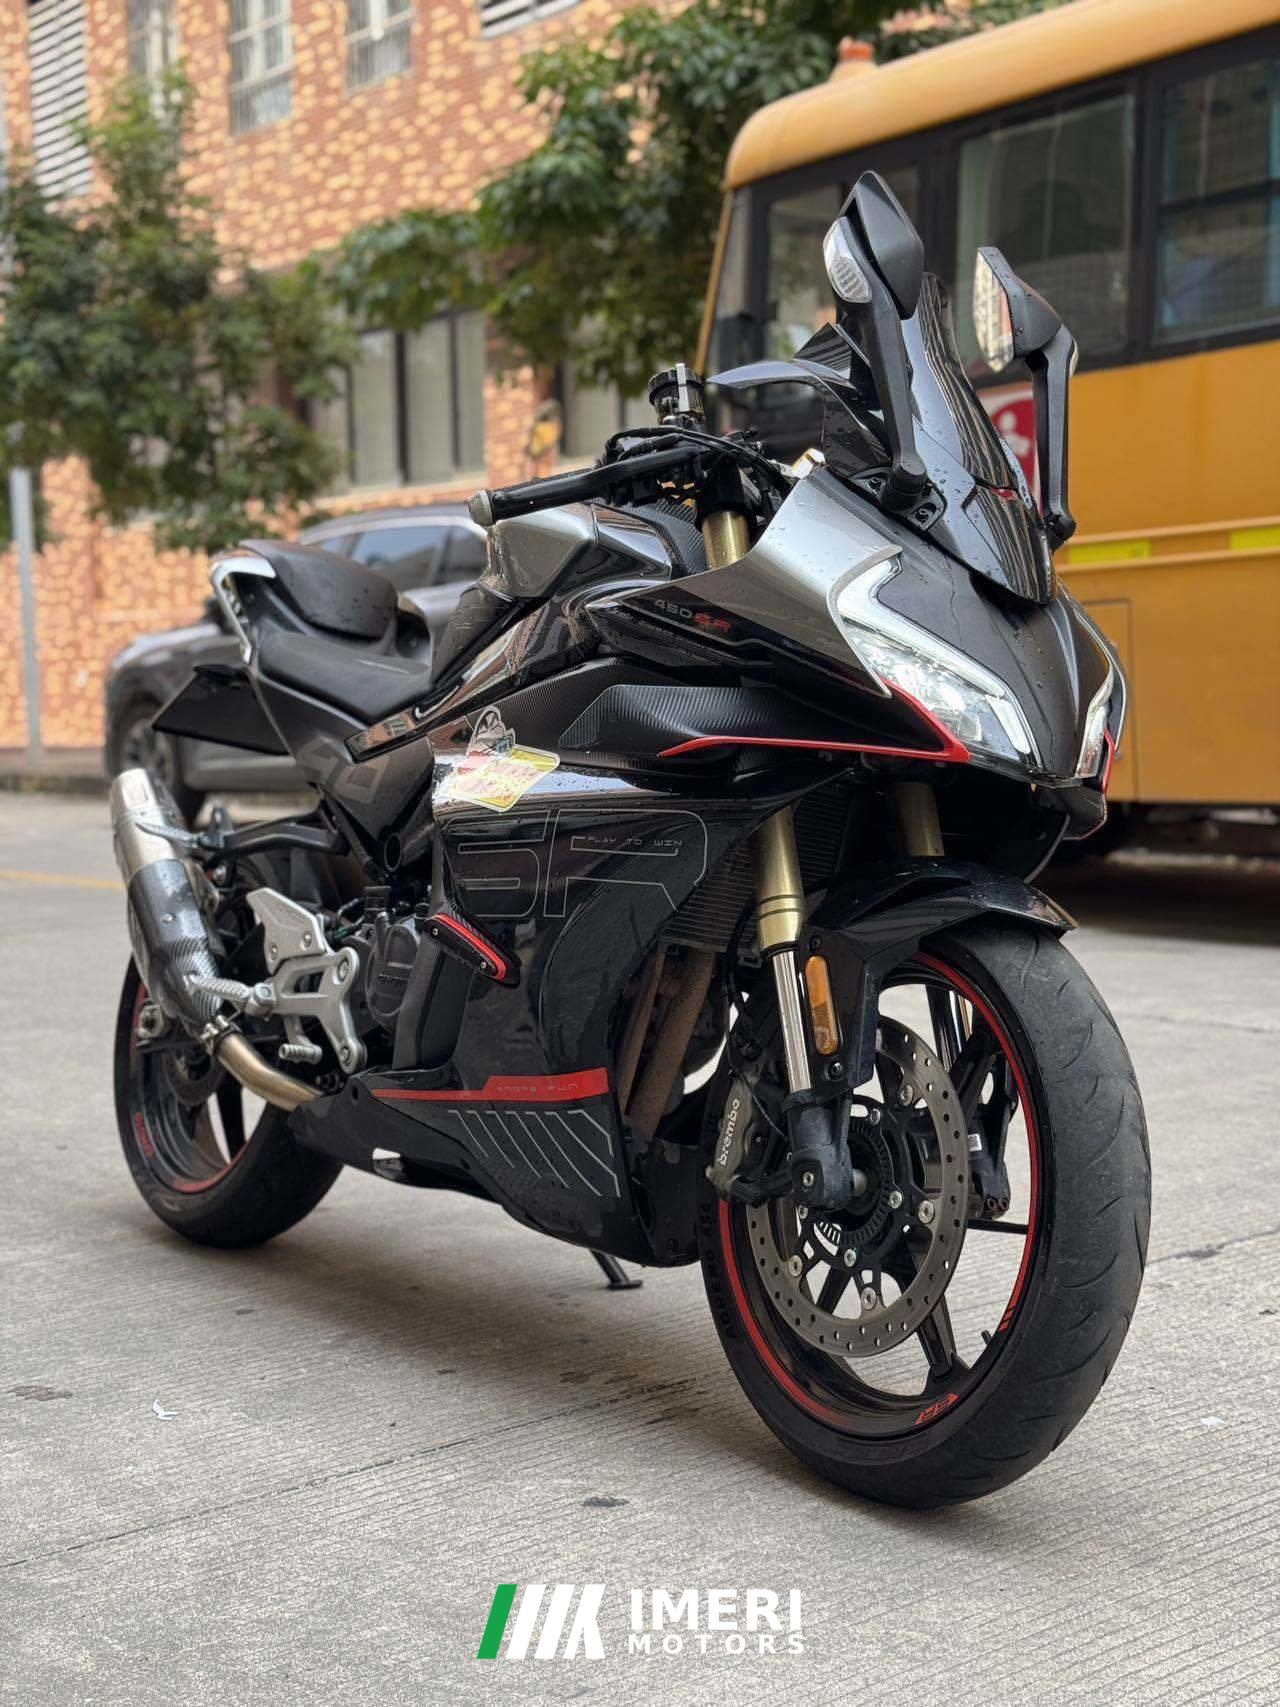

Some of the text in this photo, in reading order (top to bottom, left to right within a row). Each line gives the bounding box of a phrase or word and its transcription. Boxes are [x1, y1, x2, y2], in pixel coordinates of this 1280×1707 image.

[586, 835, 617, 845] PLAY
[625, 837, 643, 847] TO
[717, 1098, 740, 1166] brembo
